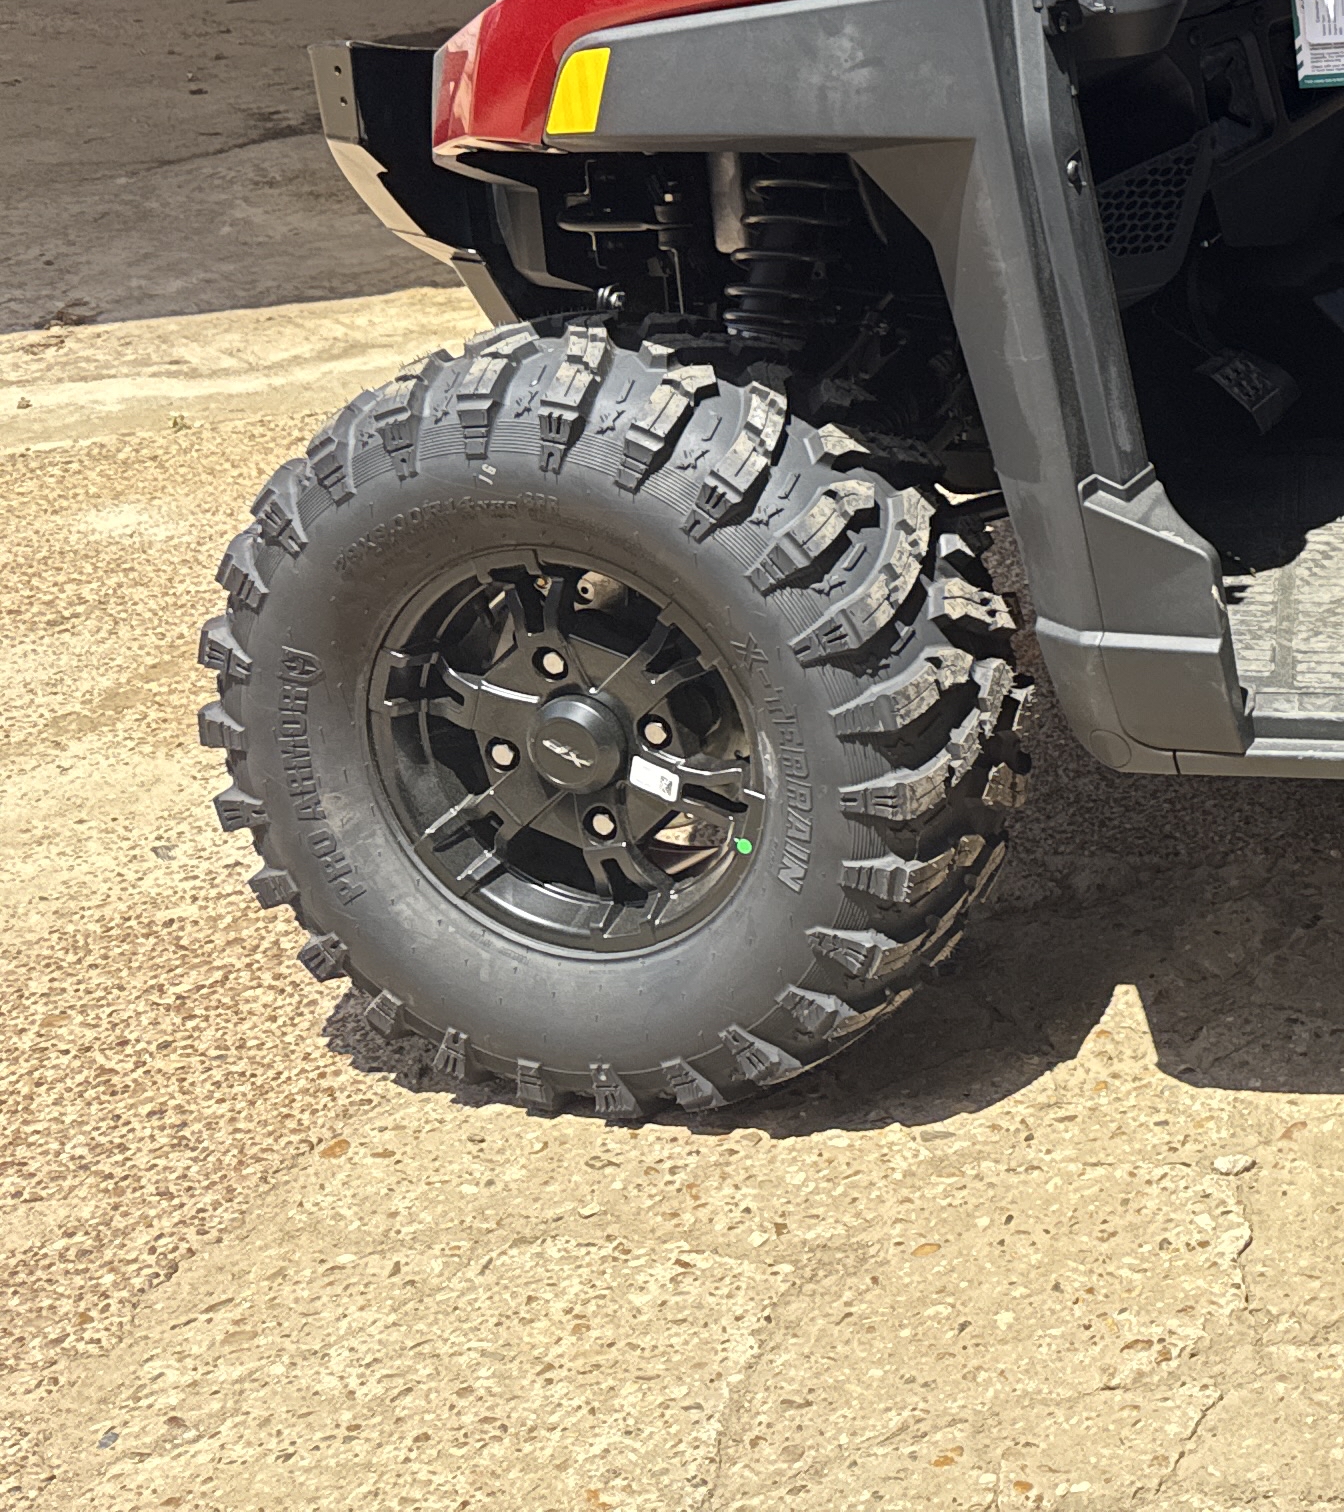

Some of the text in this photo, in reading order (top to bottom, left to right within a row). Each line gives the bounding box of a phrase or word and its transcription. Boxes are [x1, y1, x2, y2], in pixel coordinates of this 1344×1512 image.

[278, 685, 368, 907] PRO ARMOR
[730, 631, 814, 895] X-TERRAIN
